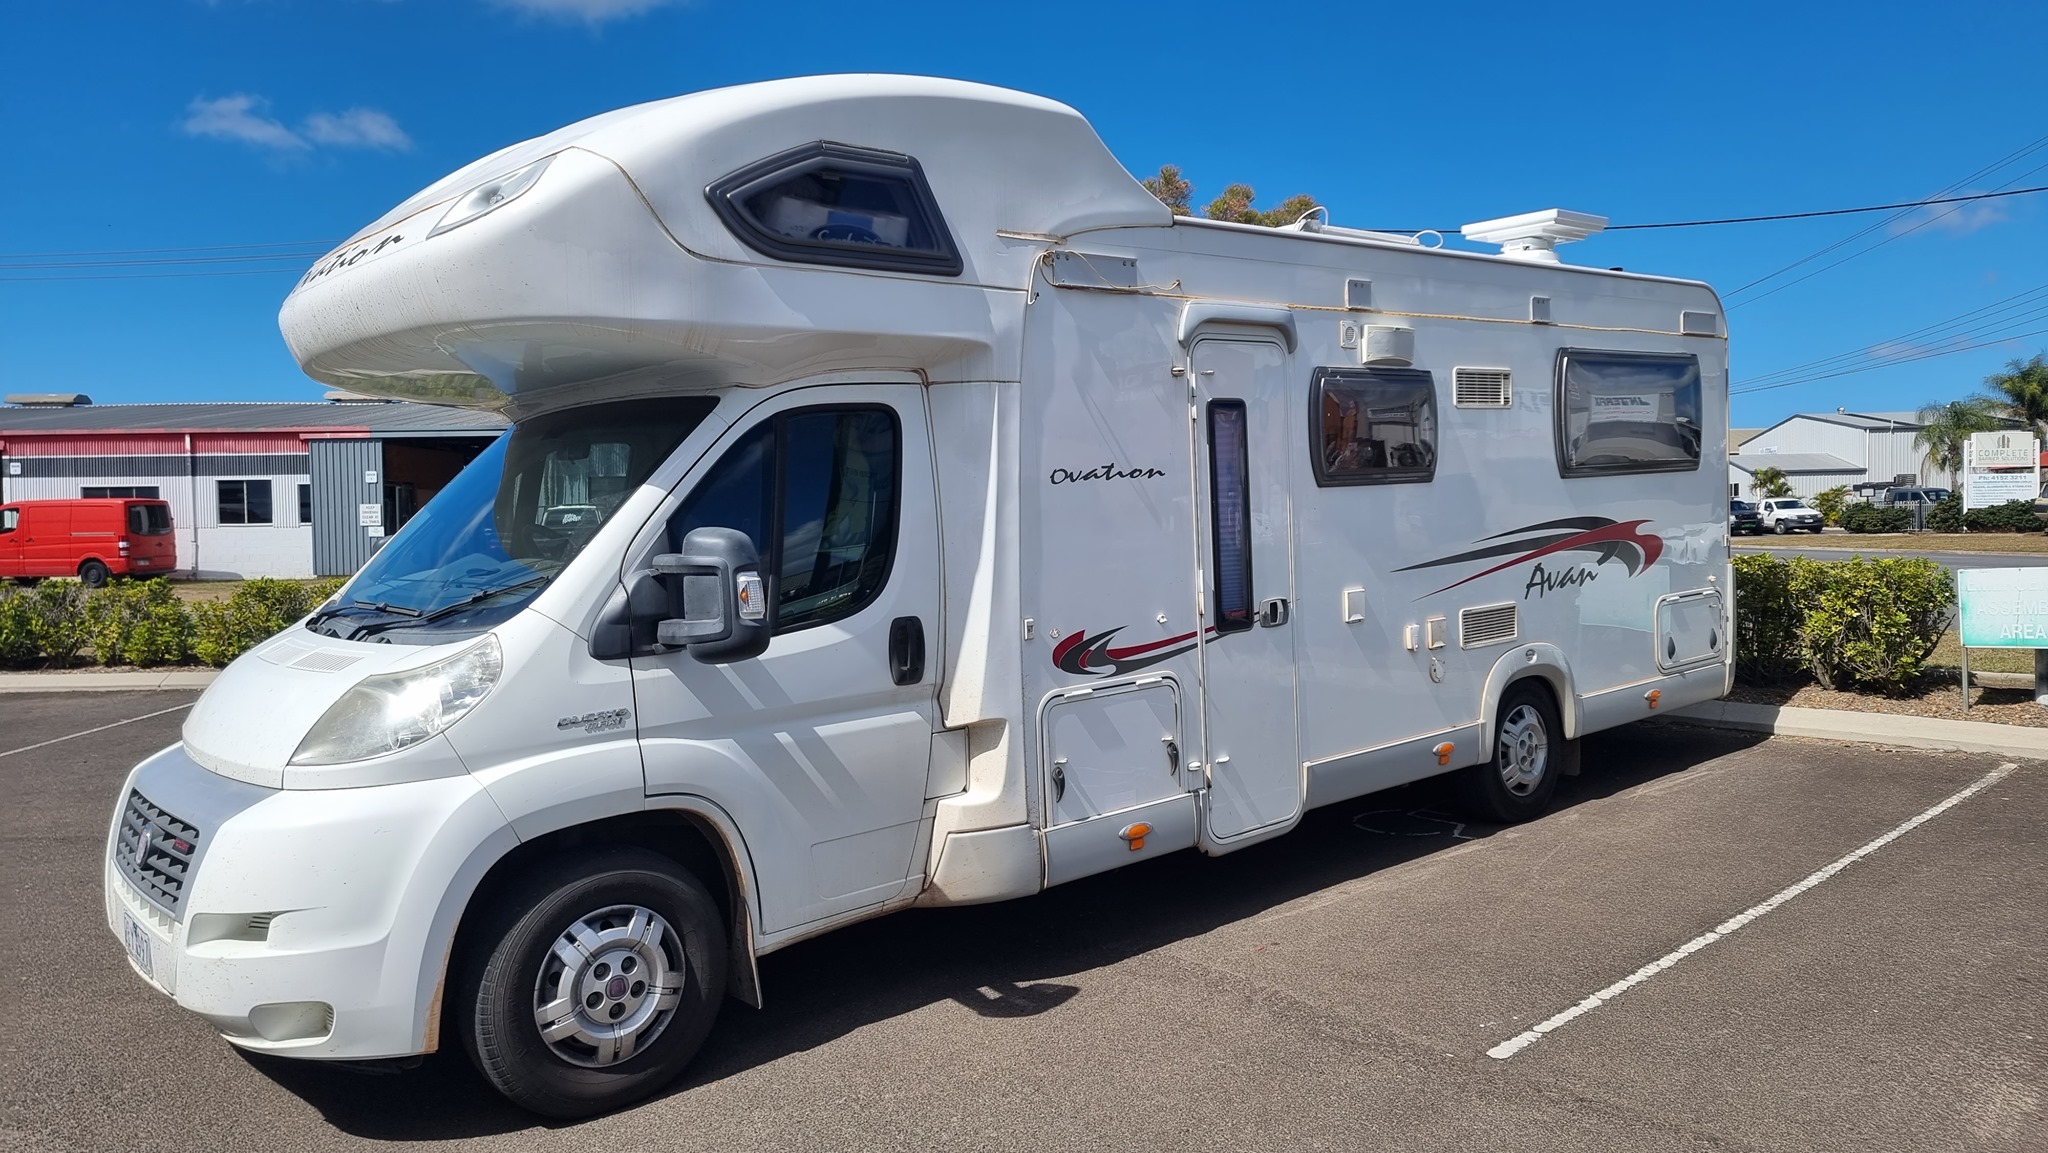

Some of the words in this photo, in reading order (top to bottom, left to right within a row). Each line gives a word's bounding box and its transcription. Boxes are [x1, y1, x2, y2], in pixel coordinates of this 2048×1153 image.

[292, 235, 405, 294] vation
[1978, 449, 2029, 457] COMPLETE
[1050, 462, 1166, 485] Ovation
[1524, 562, 1599, 600] Avan
[2000, 623, 2047, 639] AREA
